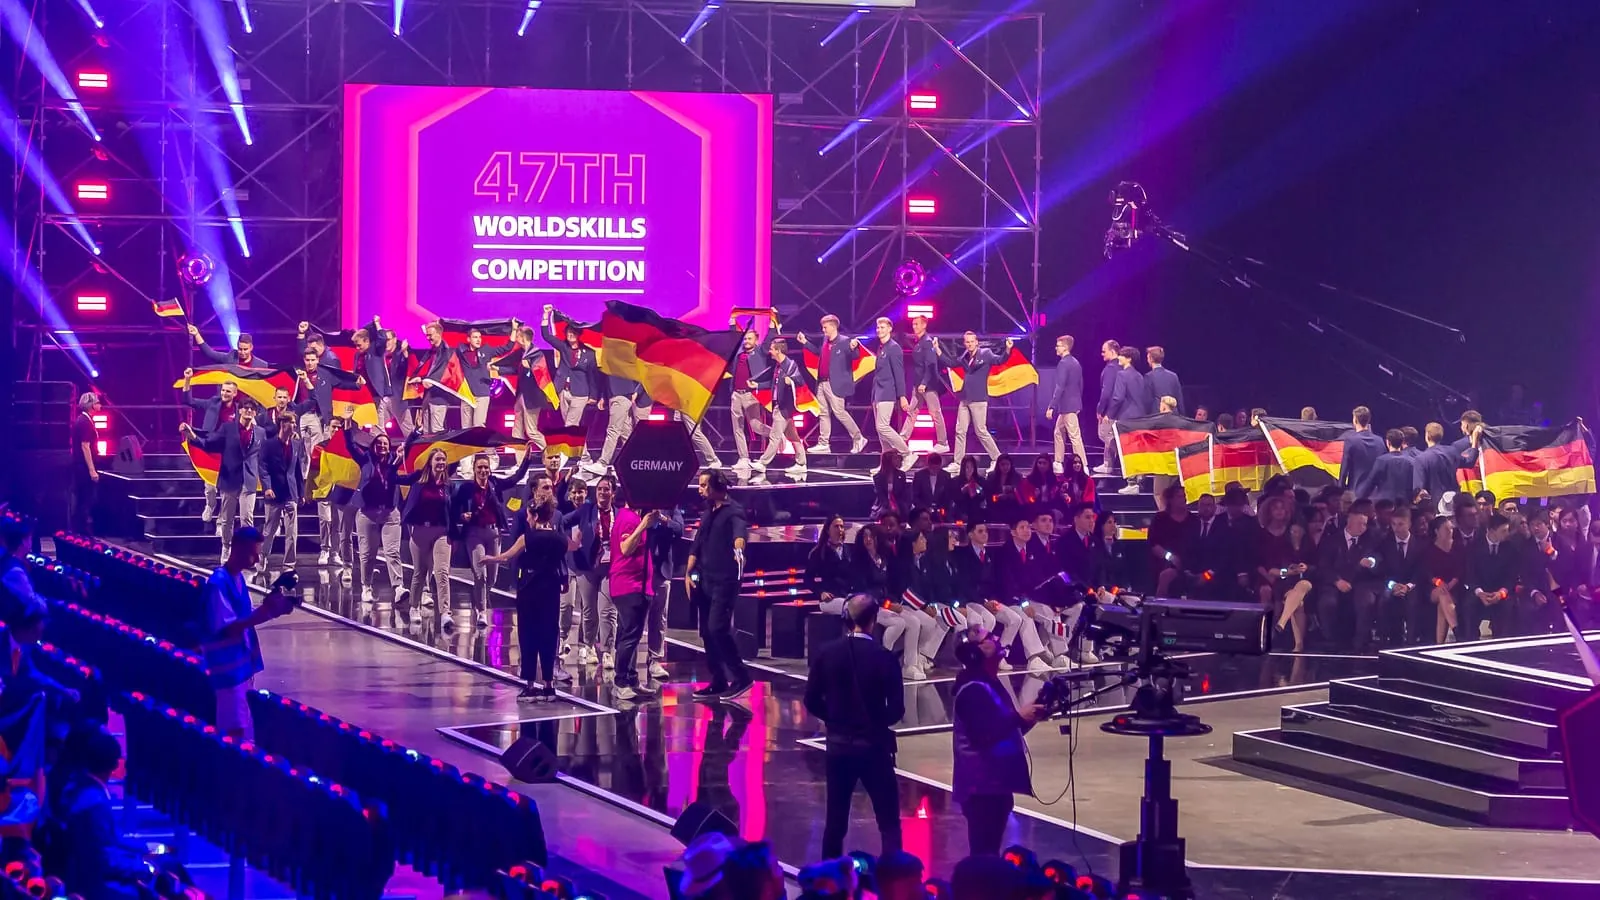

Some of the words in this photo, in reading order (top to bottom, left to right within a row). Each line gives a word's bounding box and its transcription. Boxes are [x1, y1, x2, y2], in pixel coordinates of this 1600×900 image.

[474, 151, 646, 204] 47TH
[473, 216, 647, 239] WORLDSKILLS
[471, 259, 645, 281] COMPETITION
[630, 460, 683, 471] GERMANY
